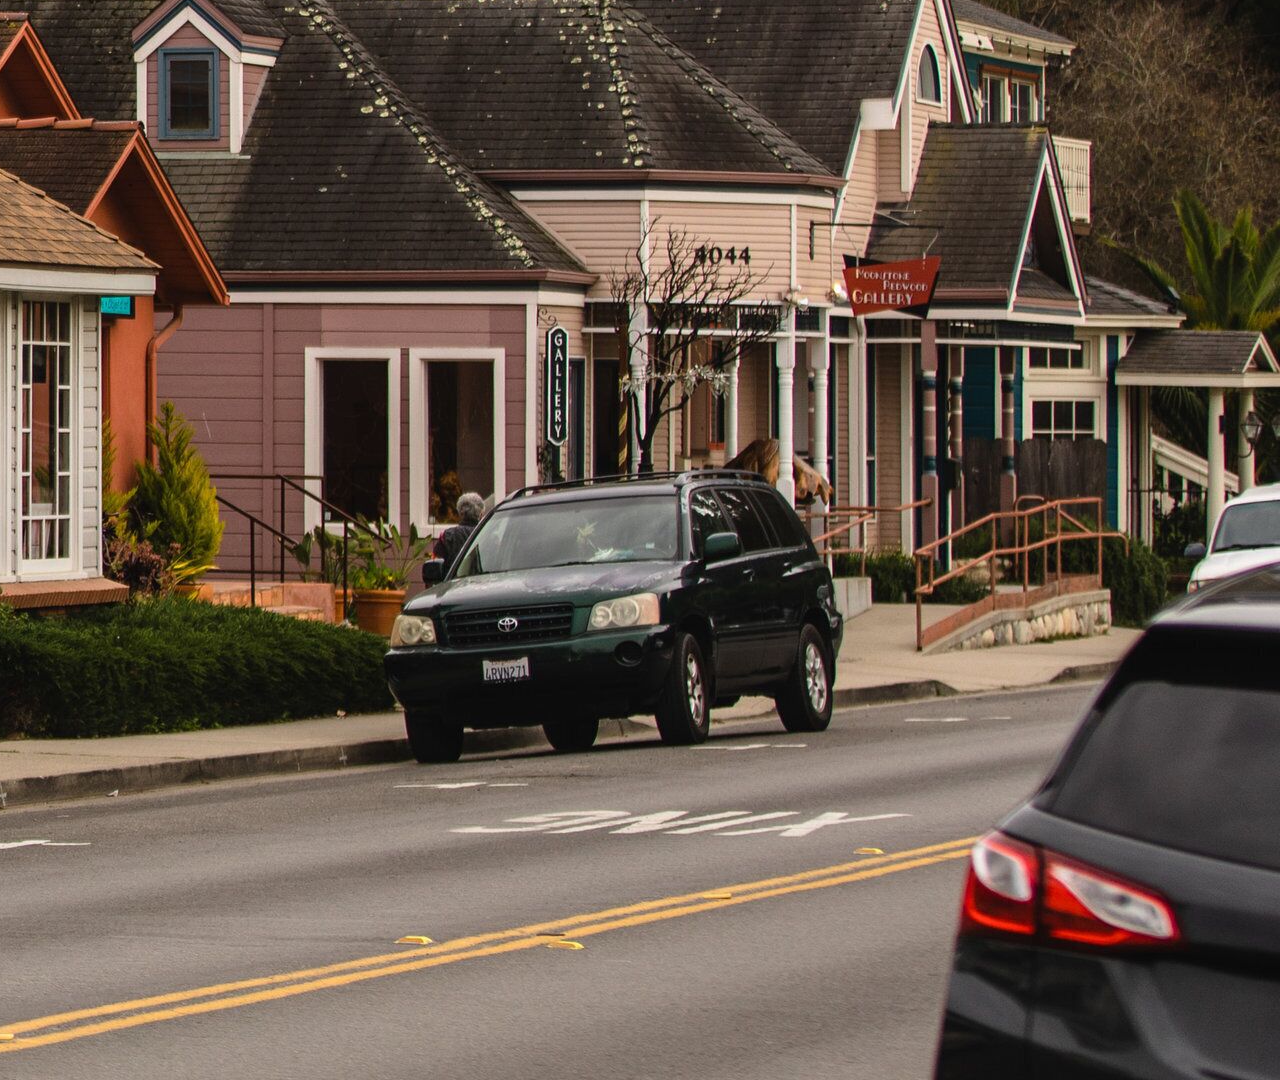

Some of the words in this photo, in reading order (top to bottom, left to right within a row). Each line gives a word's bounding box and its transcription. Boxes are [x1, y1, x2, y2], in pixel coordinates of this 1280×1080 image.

[695, 245, 752, 265] 4044
[852, 289, 913, 305] GALLERY
[554, 334, 564, 438] GALLERY
